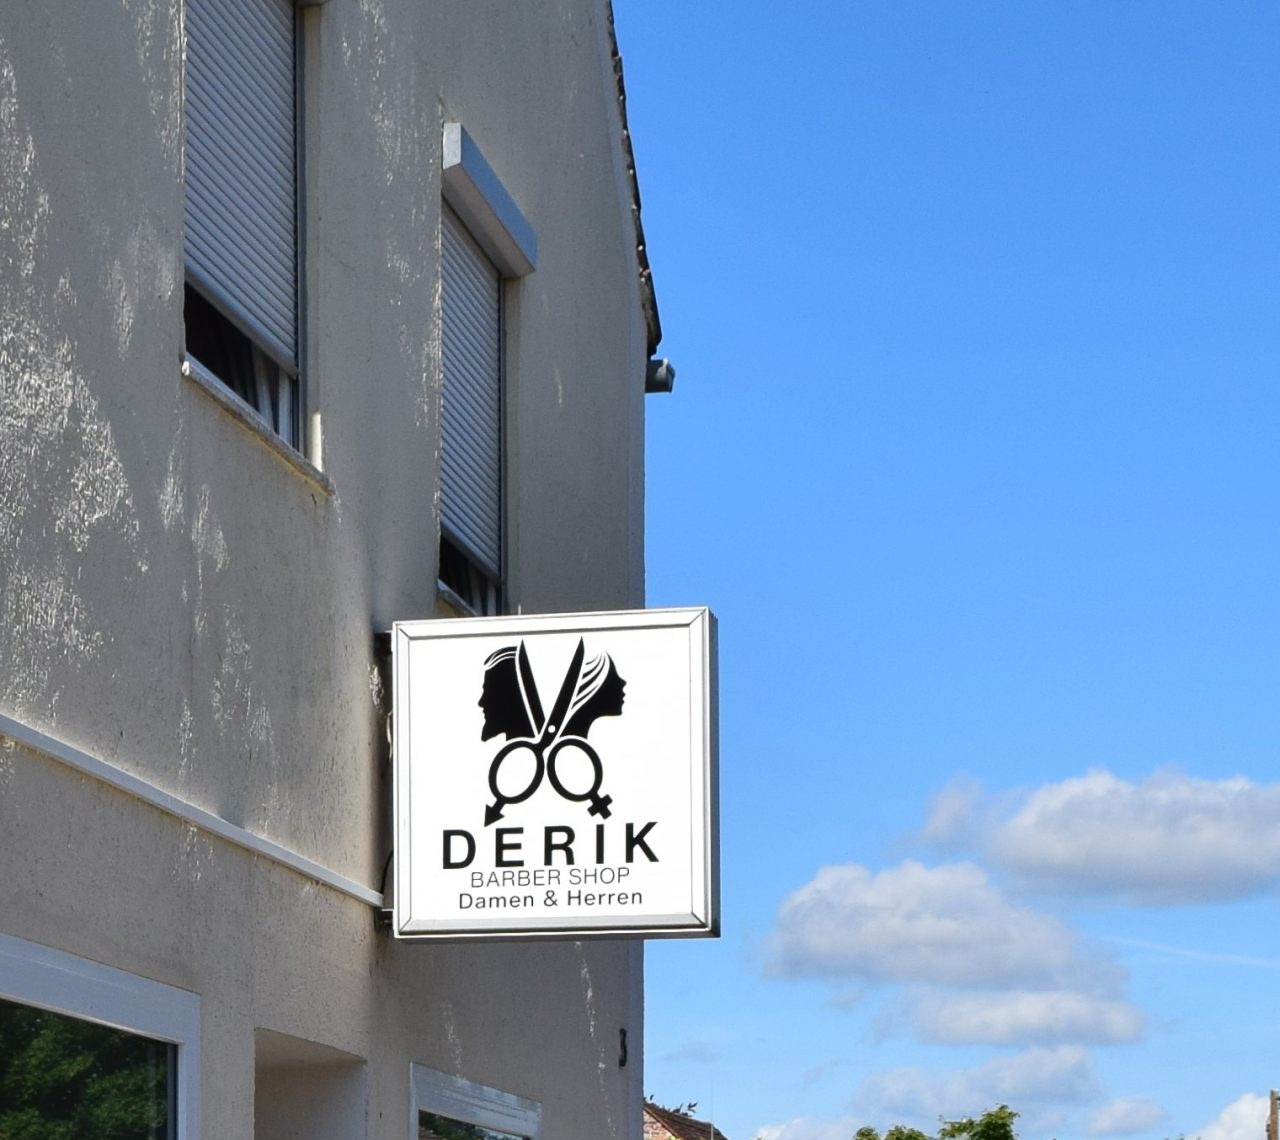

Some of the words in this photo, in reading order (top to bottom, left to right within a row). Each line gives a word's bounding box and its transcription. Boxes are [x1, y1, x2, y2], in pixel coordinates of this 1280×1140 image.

[442, 821, 660, 870] DERIK
[470, 869, 562, 888] BARBER
[568, 867, 631, 885] SHOP
[458, 892, 535, 910] Damen
[542, 890, 559, 907] &
[566, 889, 643, 907] Herren
